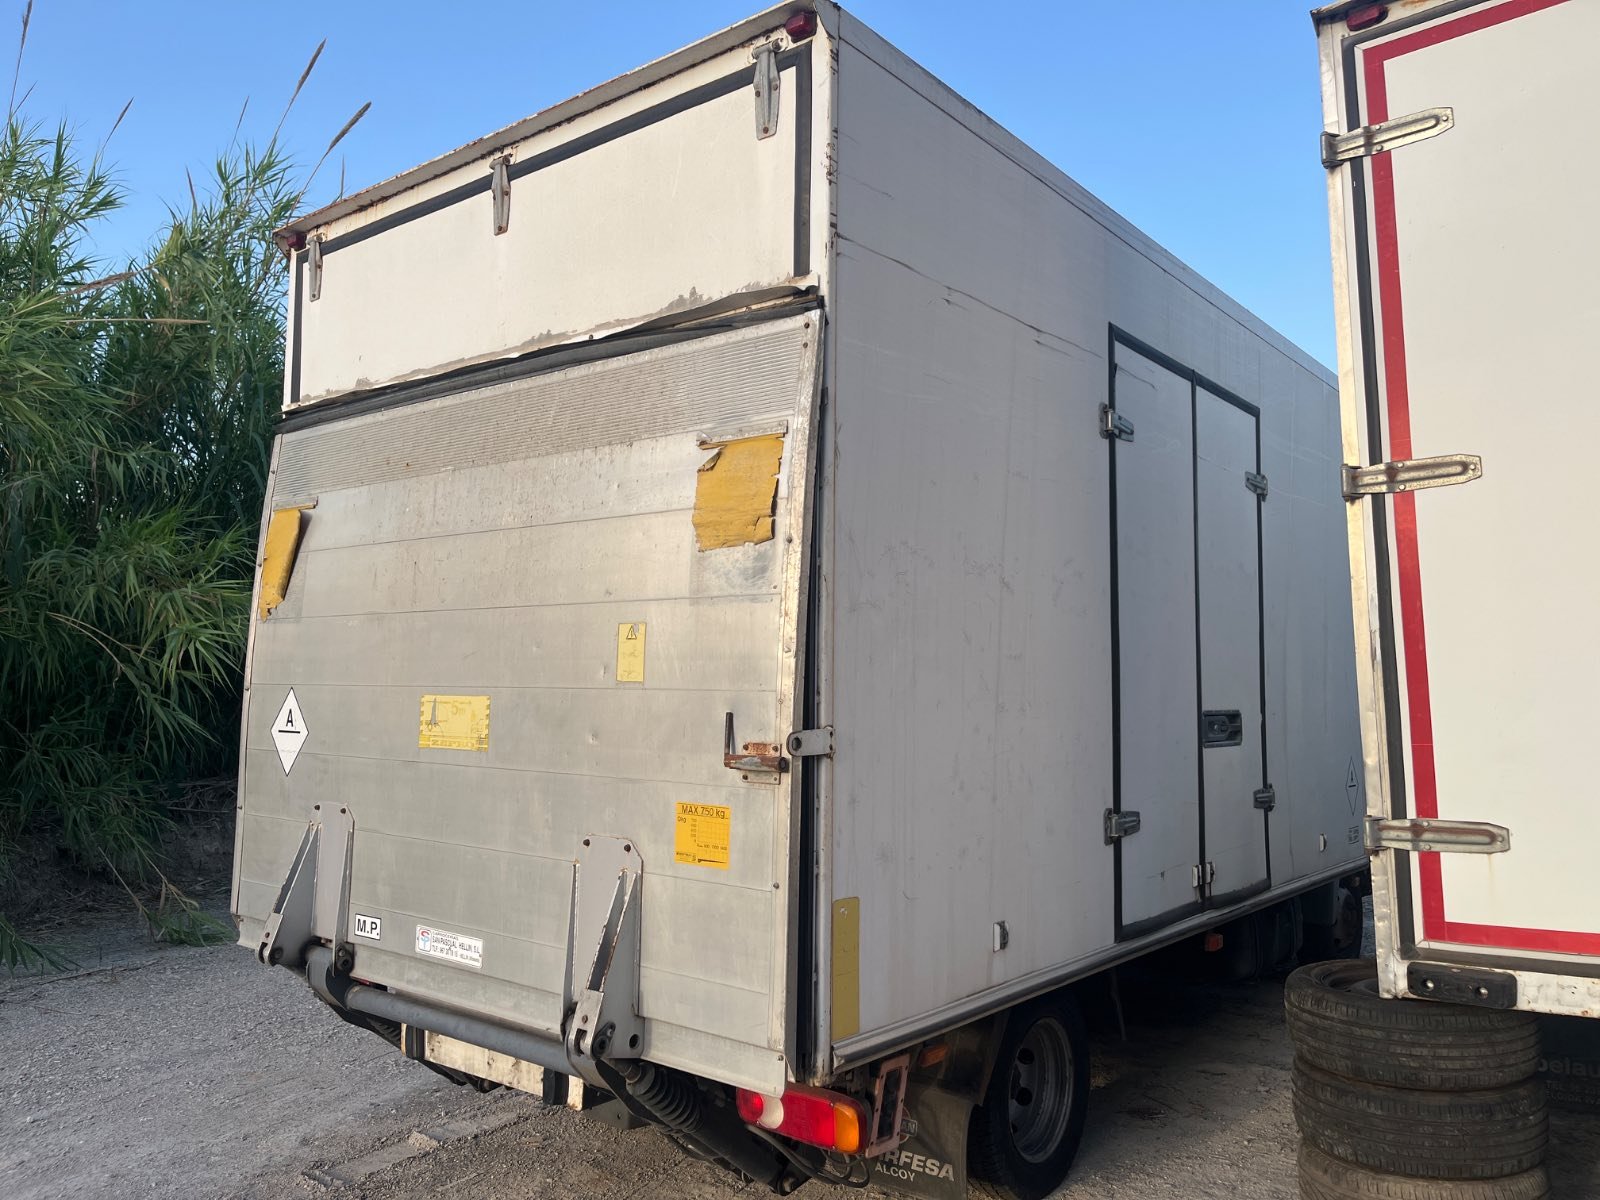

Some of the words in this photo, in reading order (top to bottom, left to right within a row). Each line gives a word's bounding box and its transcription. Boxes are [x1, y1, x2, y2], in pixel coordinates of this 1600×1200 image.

[285, 708, 294, 727] A
[681, 805, 699, 815] MAX
[700, 806, 715, 817] 750
[715, 808, 726, 820] kg
[356, 918, 380, 937] M.P.
[874, 1162, 916, 1182] ALCOY
[879, 1148, 955, 1182] RFESA
